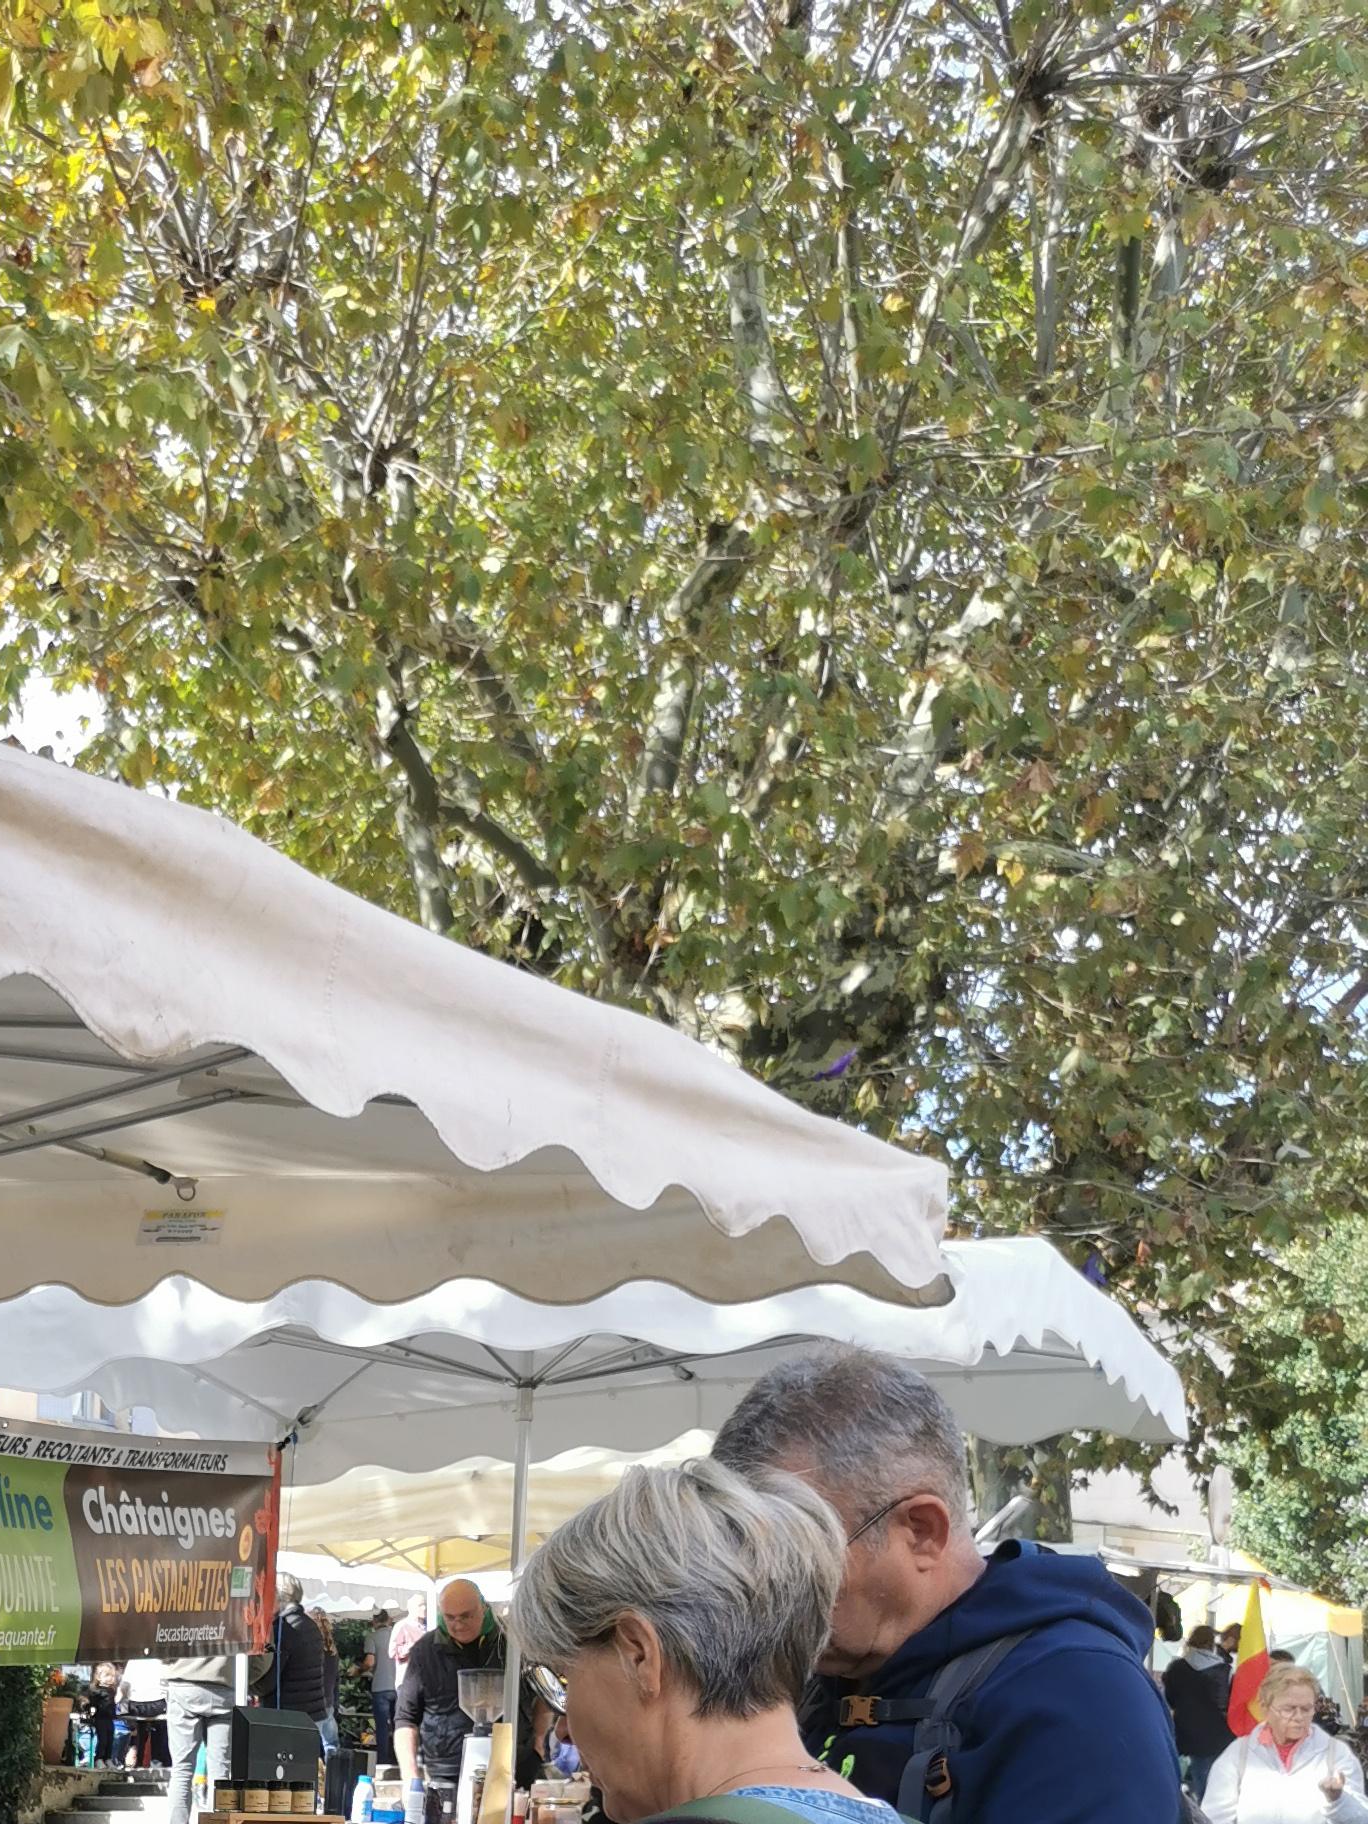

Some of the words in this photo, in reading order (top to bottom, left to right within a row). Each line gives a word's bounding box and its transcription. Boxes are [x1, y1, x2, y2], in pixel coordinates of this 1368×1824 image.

[33, 1440, 115, 1465] RECOLTANTS
[123, 1450, 229, 1472] TRANSFORMATEURS
[82, 1486, 237, 1549] Châtaignes
[96, 1558, 130, 1613] LES
[132, 1558, 233, 1613] CASTAGNETTES
[155, 1621, 226, 1646] lescastagnettes.fr
